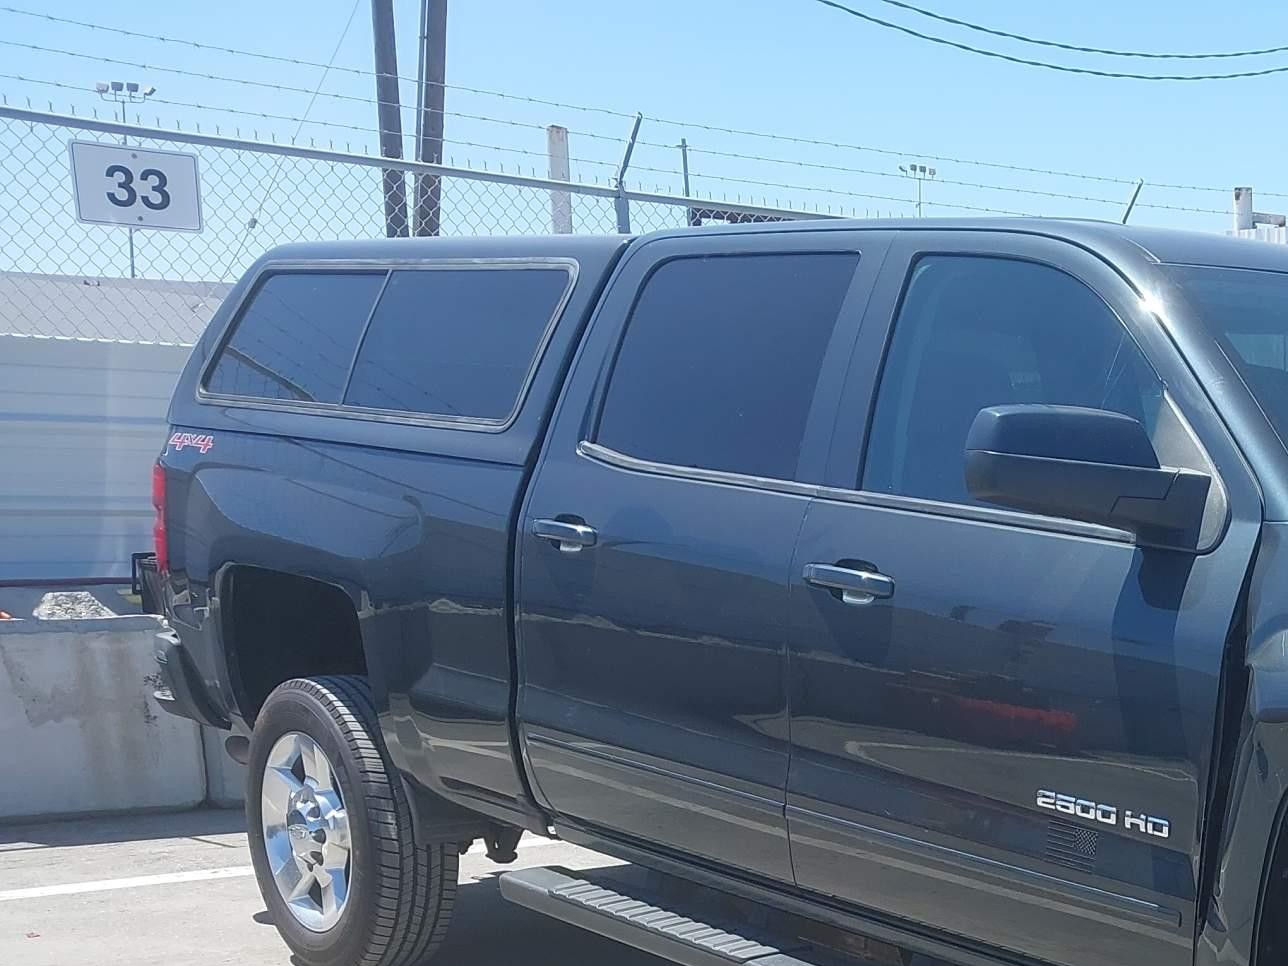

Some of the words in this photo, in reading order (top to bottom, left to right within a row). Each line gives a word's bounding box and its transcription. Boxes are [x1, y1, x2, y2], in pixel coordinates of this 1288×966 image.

[105, 165, 170, 211] 33
[1036, 789, 1117, 825] 2500
[1124, 810, 1169, 838] HD
